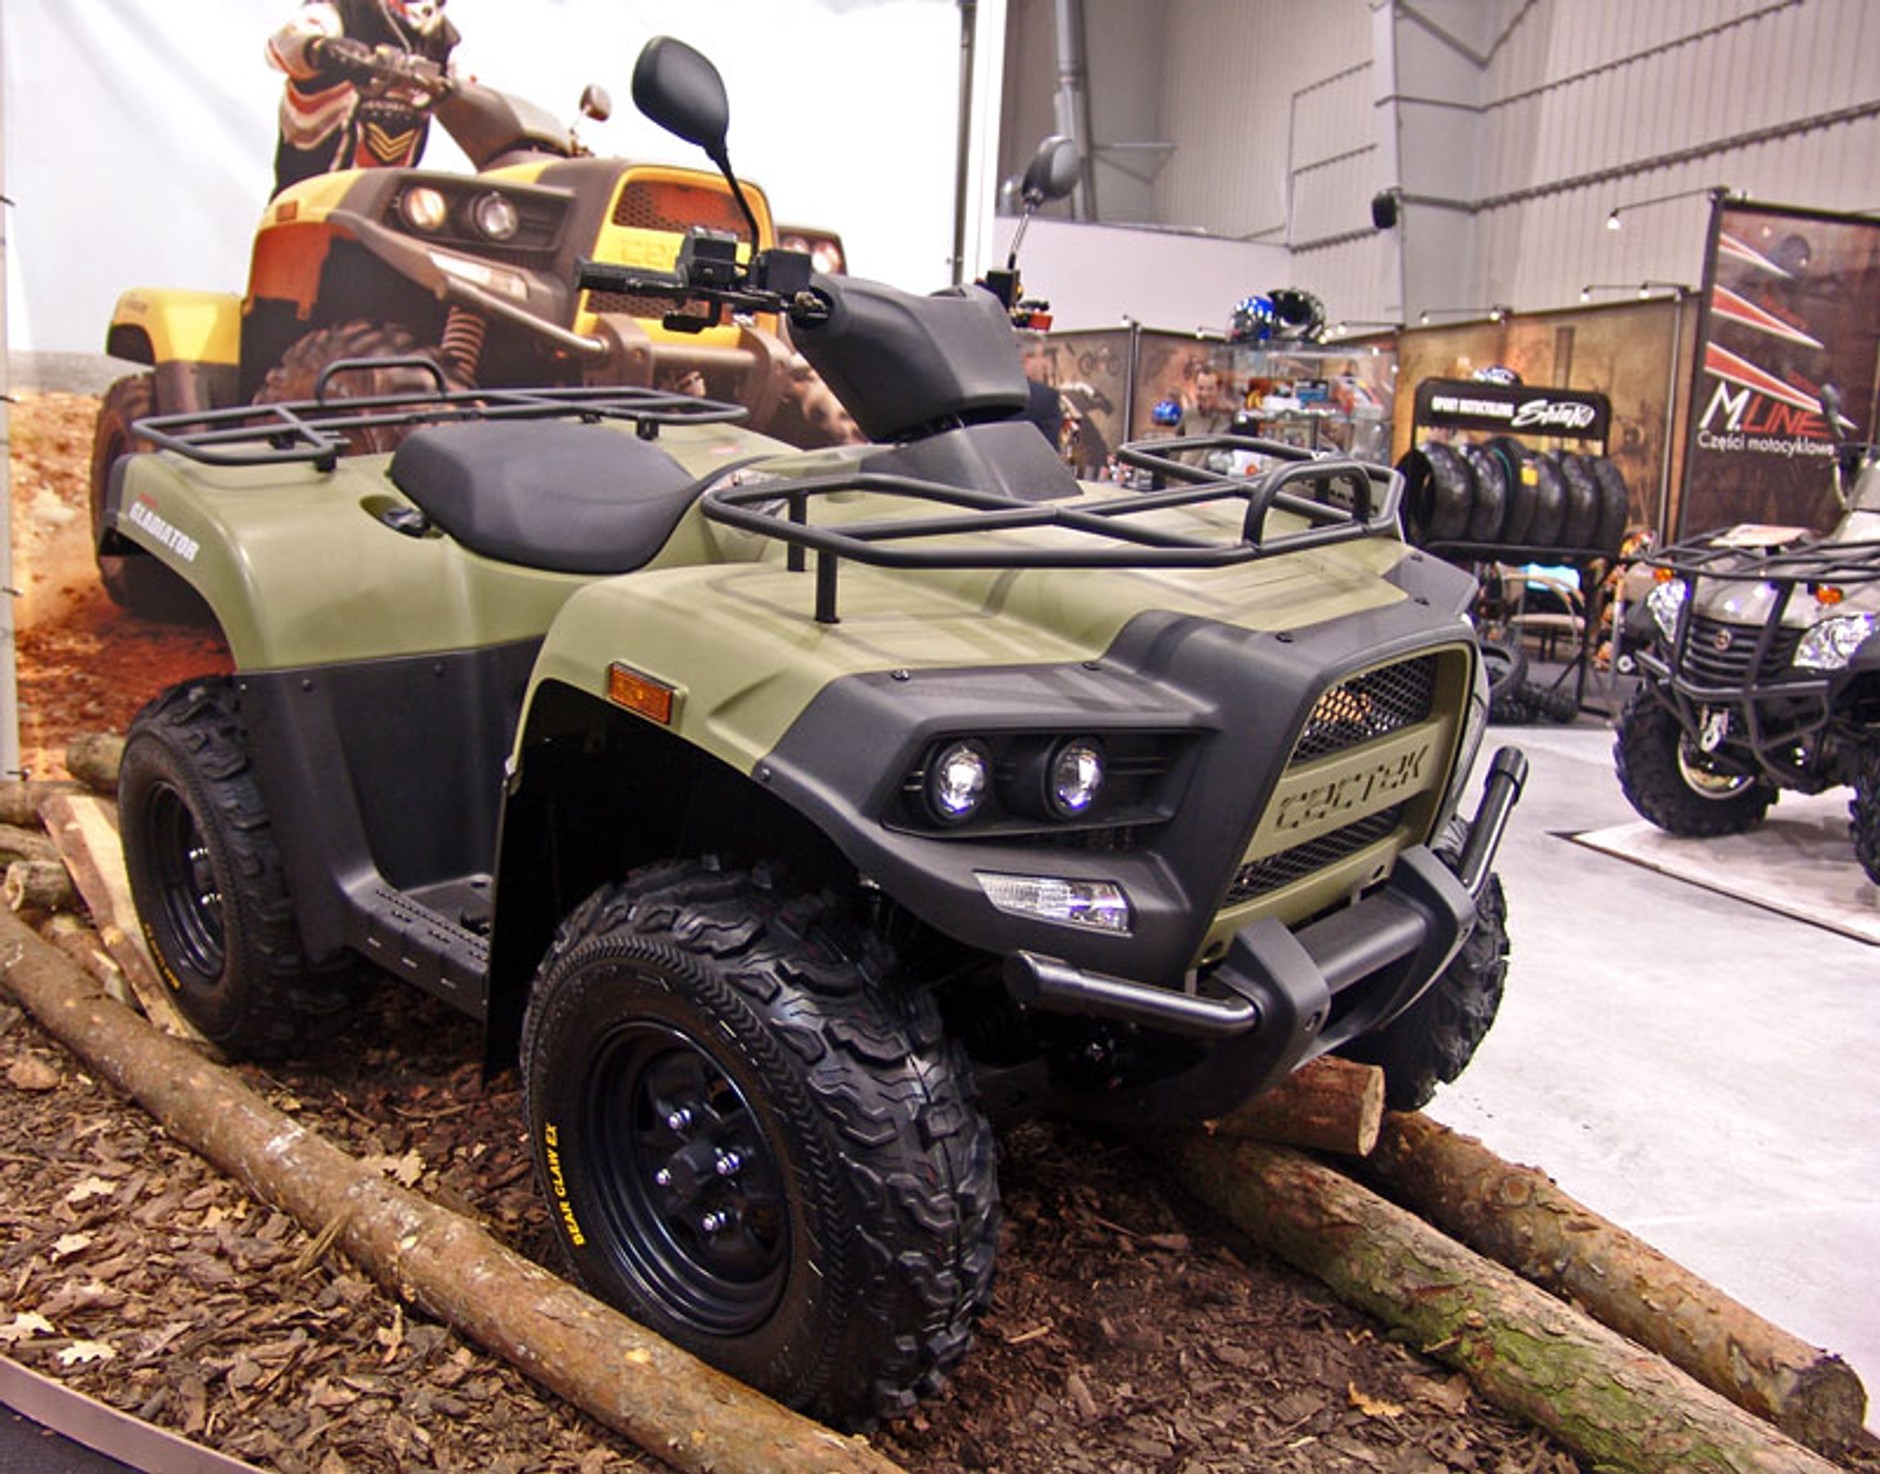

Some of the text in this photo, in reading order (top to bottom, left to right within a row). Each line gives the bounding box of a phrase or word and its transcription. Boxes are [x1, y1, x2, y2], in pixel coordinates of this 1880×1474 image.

[1697, 429, 1835, 457] Części motocyklowe
[128, 500, 200, 562] GLADIATOR
[545, 1122, 586, 1245] BEAR CLAW EX
